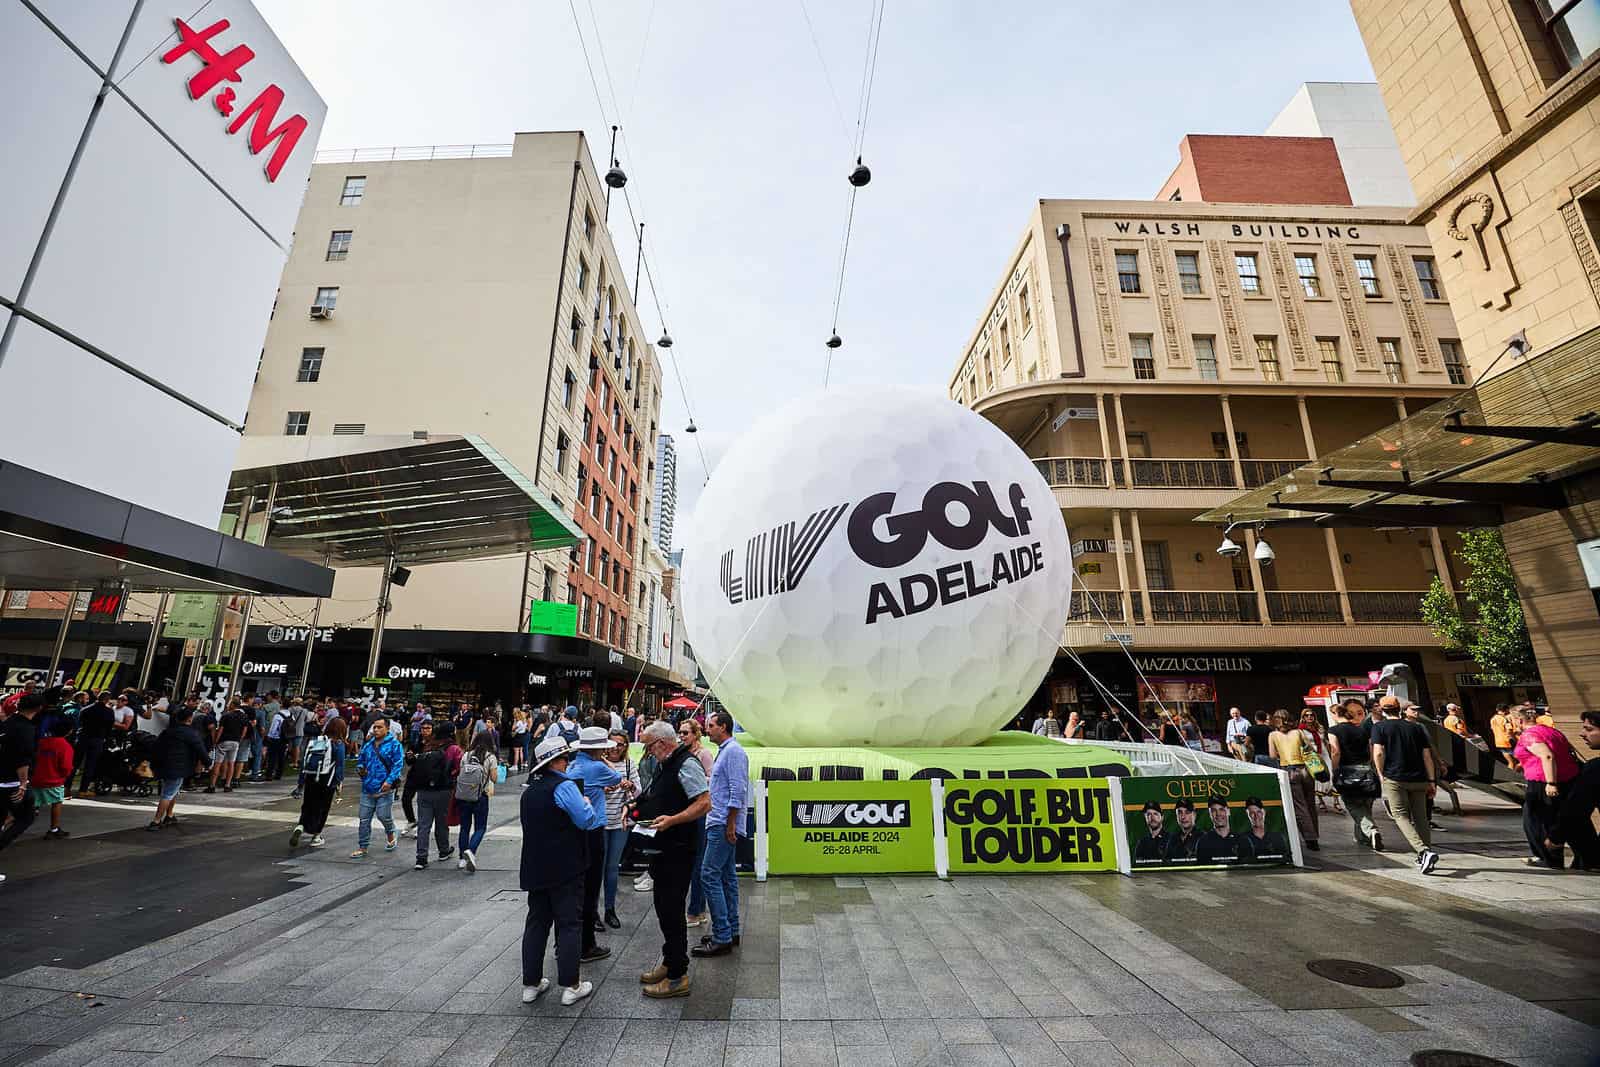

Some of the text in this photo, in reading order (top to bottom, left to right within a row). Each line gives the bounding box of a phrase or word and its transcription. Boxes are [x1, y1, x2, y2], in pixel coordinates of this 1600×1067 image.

[160, 17, 308, 183] H&M
[1114, 221, 1361, 240] WALSH BUILDING
[720, 480, 1034, 605] LIV GOLF
[865, 541, 1045, 625] ADELAIDE
[284, 628, 334, 643] HYPE
[254, 663, 288, 674] HYPE
[400, 667, 436, 679] HYPE
[565, 668, 593, 678] HYPE
[1166, 779, 1232, 798] CLEEKS
[797, 803, 906, 825] LIV GOLF
[945, 787, 1111, 826] GOLF, BUT
[803, 831, 900, 843] ADELAIDE 2024
[960, 826, 1104, 864] LOUDER
[823, 845, 880, 855] 26-28 APRIL
